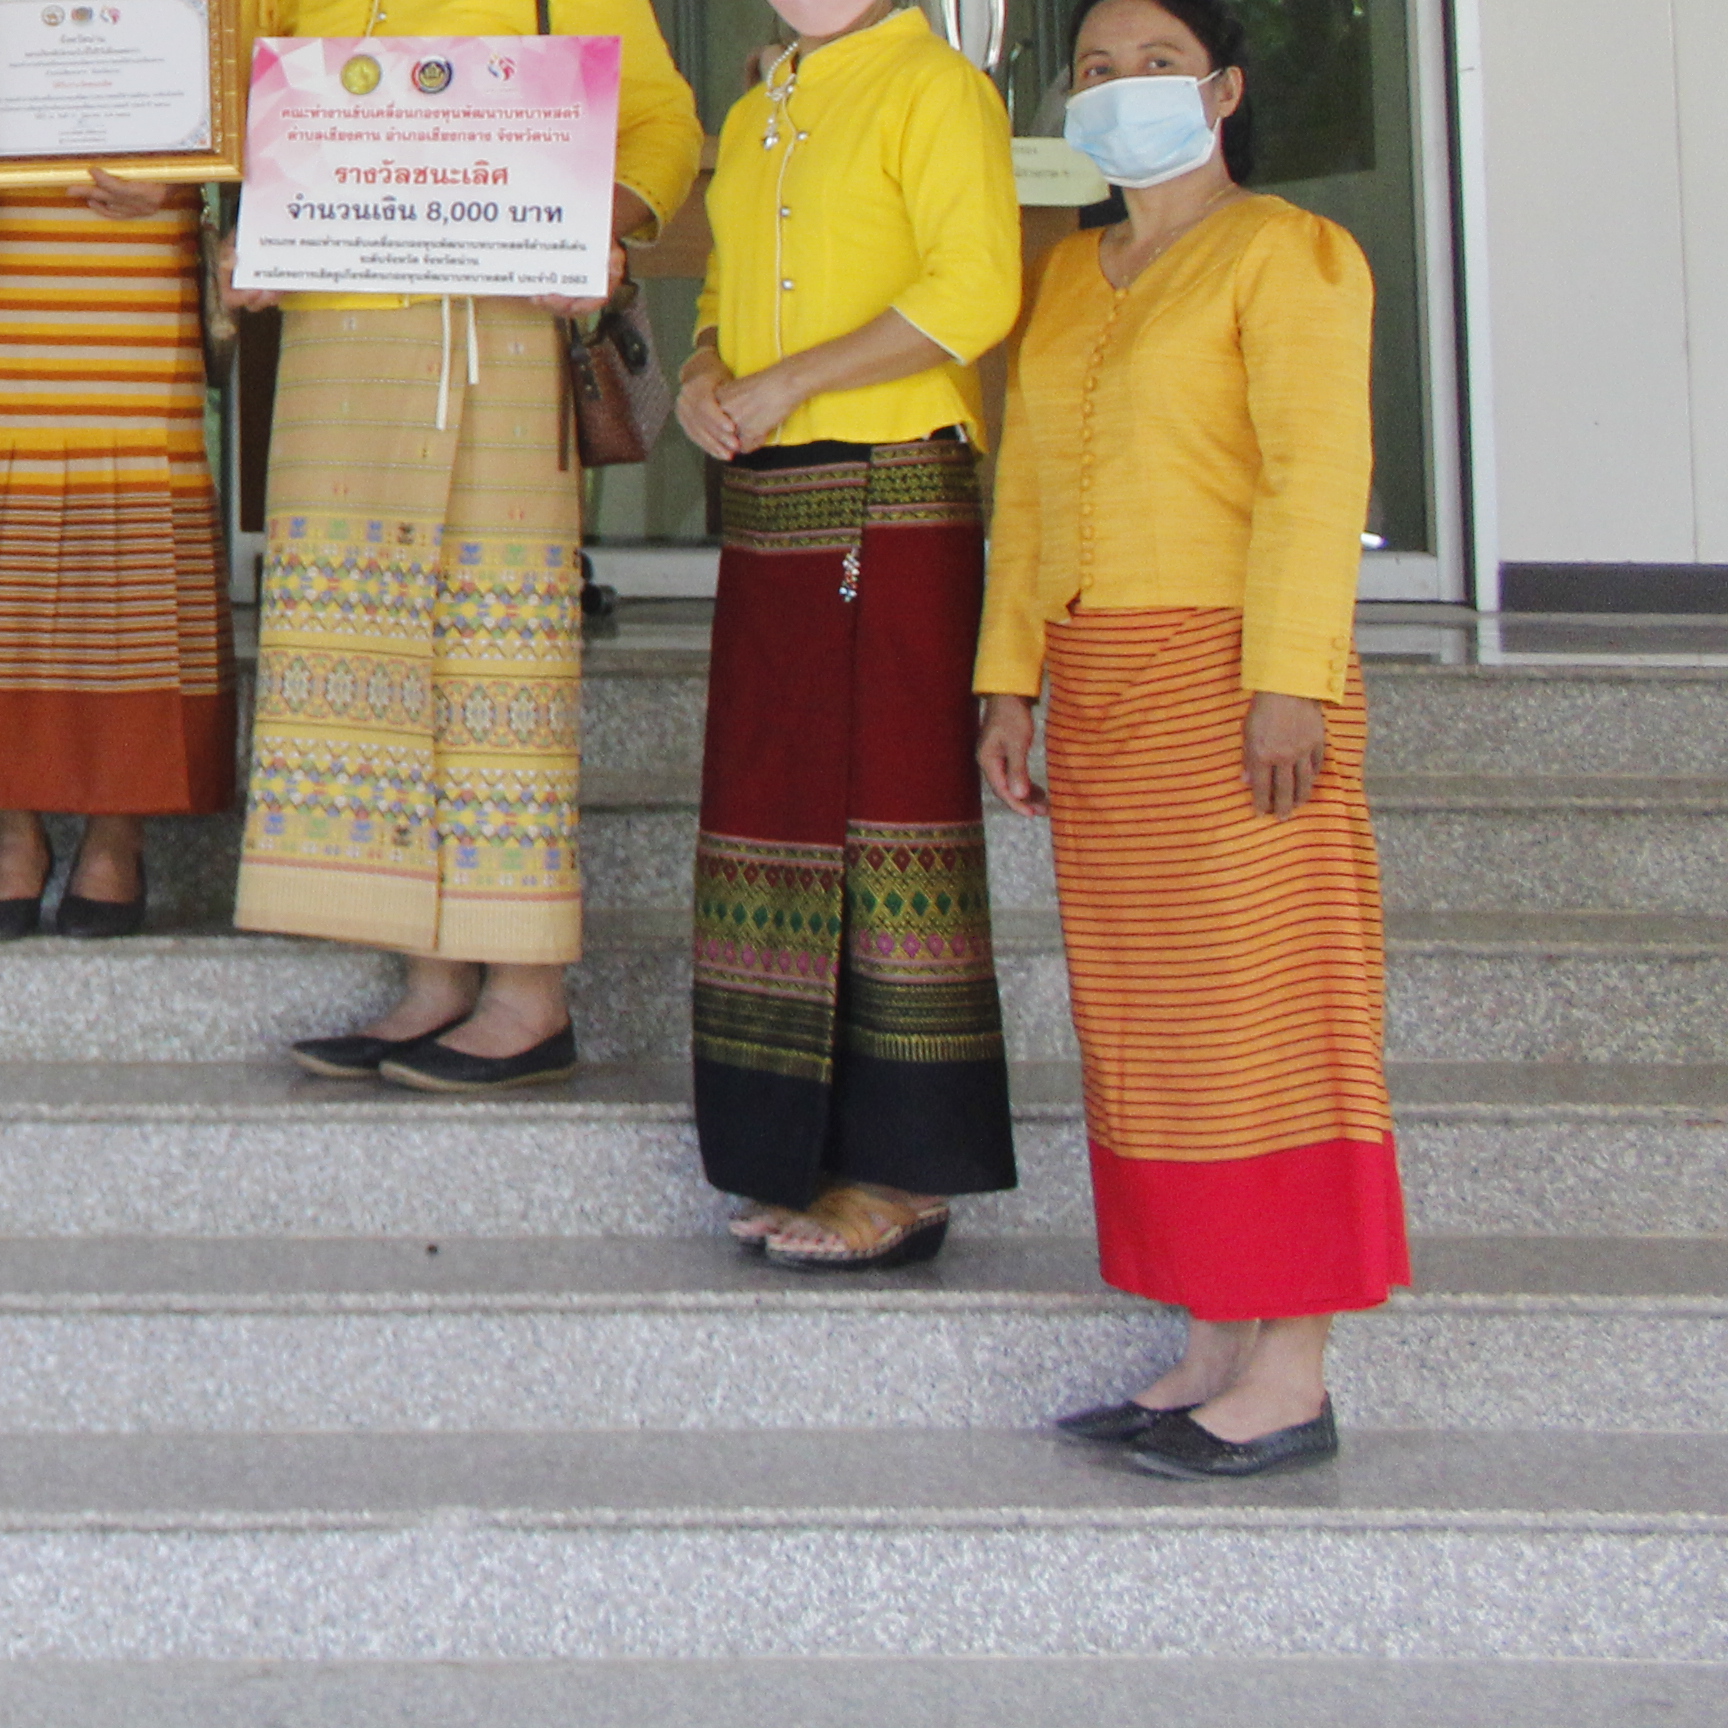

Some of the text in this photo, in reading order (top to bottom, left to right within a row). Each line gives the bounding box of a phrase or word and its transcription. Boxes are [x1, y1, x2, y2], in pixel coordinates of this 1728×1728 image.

[334, 159, 508, 185] รางวัลชนะเลิศ
[287, 193, 562, 225] จำนวนเงิน 8,000 บาท
